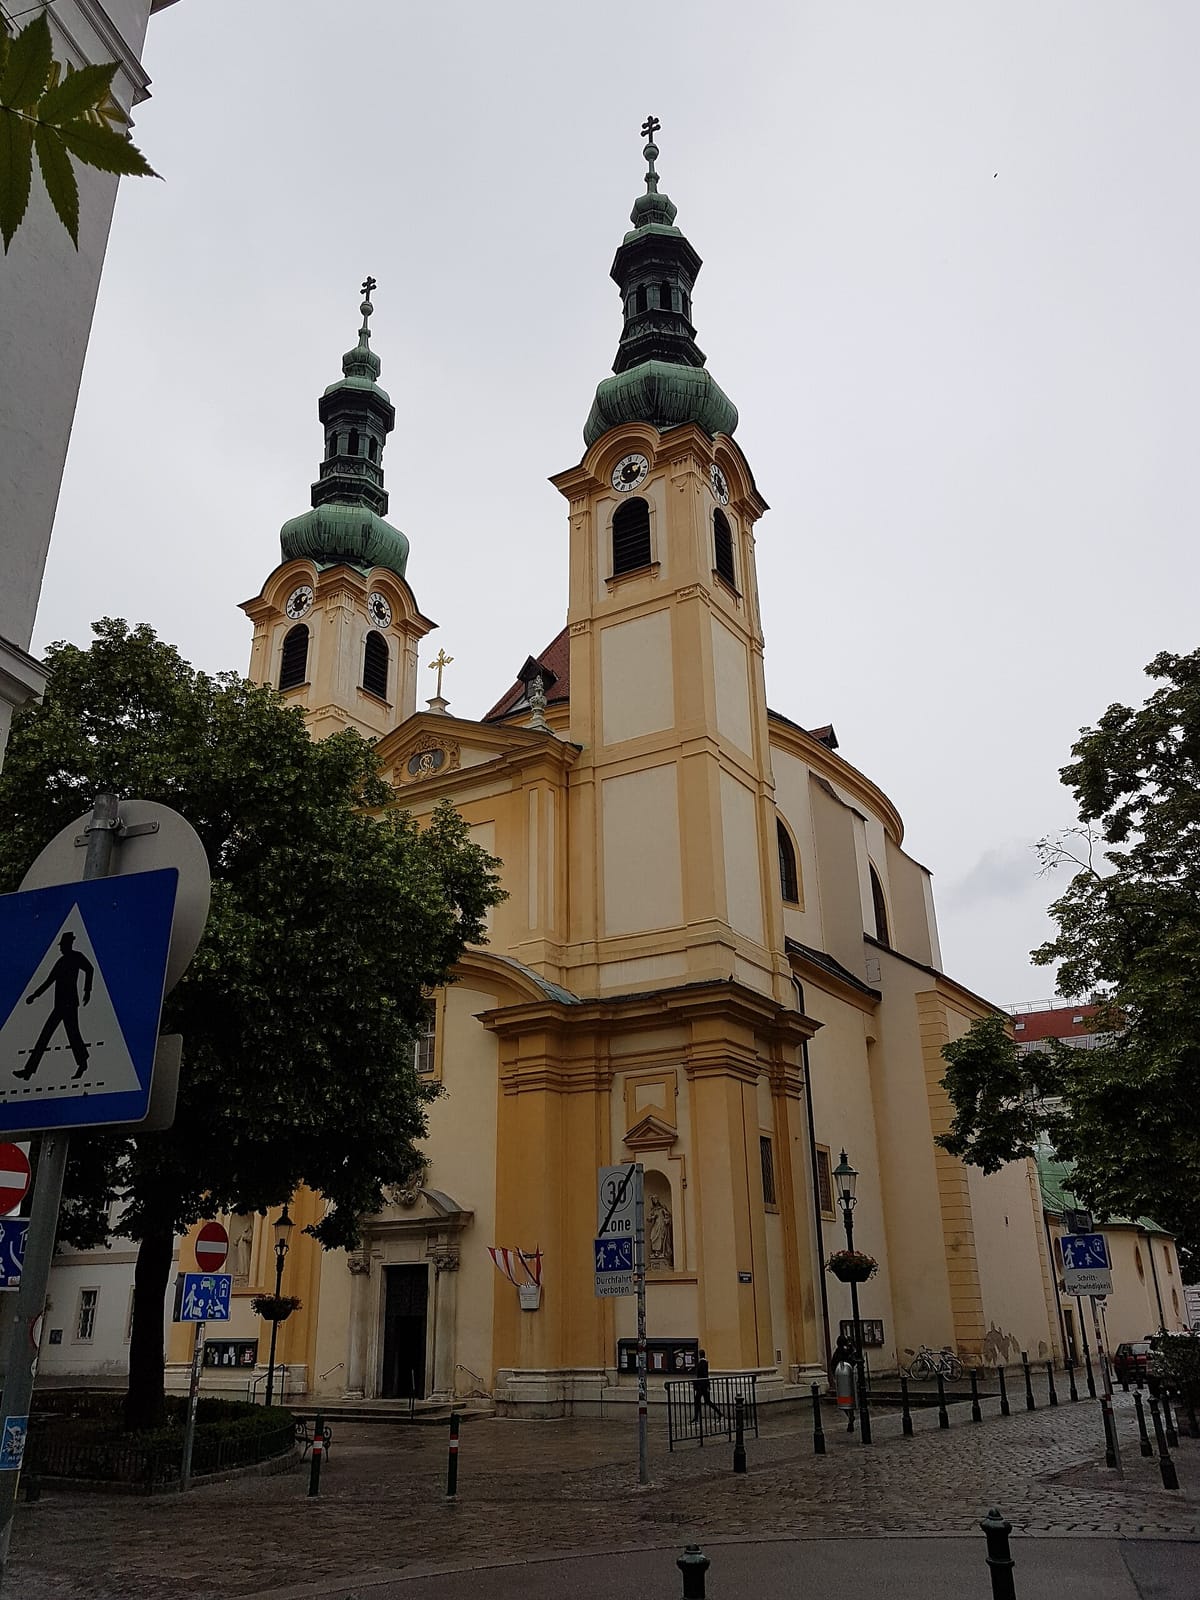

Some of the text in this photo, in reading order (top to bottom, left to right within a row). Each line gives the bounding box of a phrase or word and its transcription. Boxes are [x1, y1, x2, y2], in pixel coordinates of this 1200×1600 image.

[607, 1180, 627, 1205] 30
[603, 1217, 631, 1232] Zone
[596, 1274, 633, 1285] Durchfahrt
[599, 1286, 630, 1295] verboten
